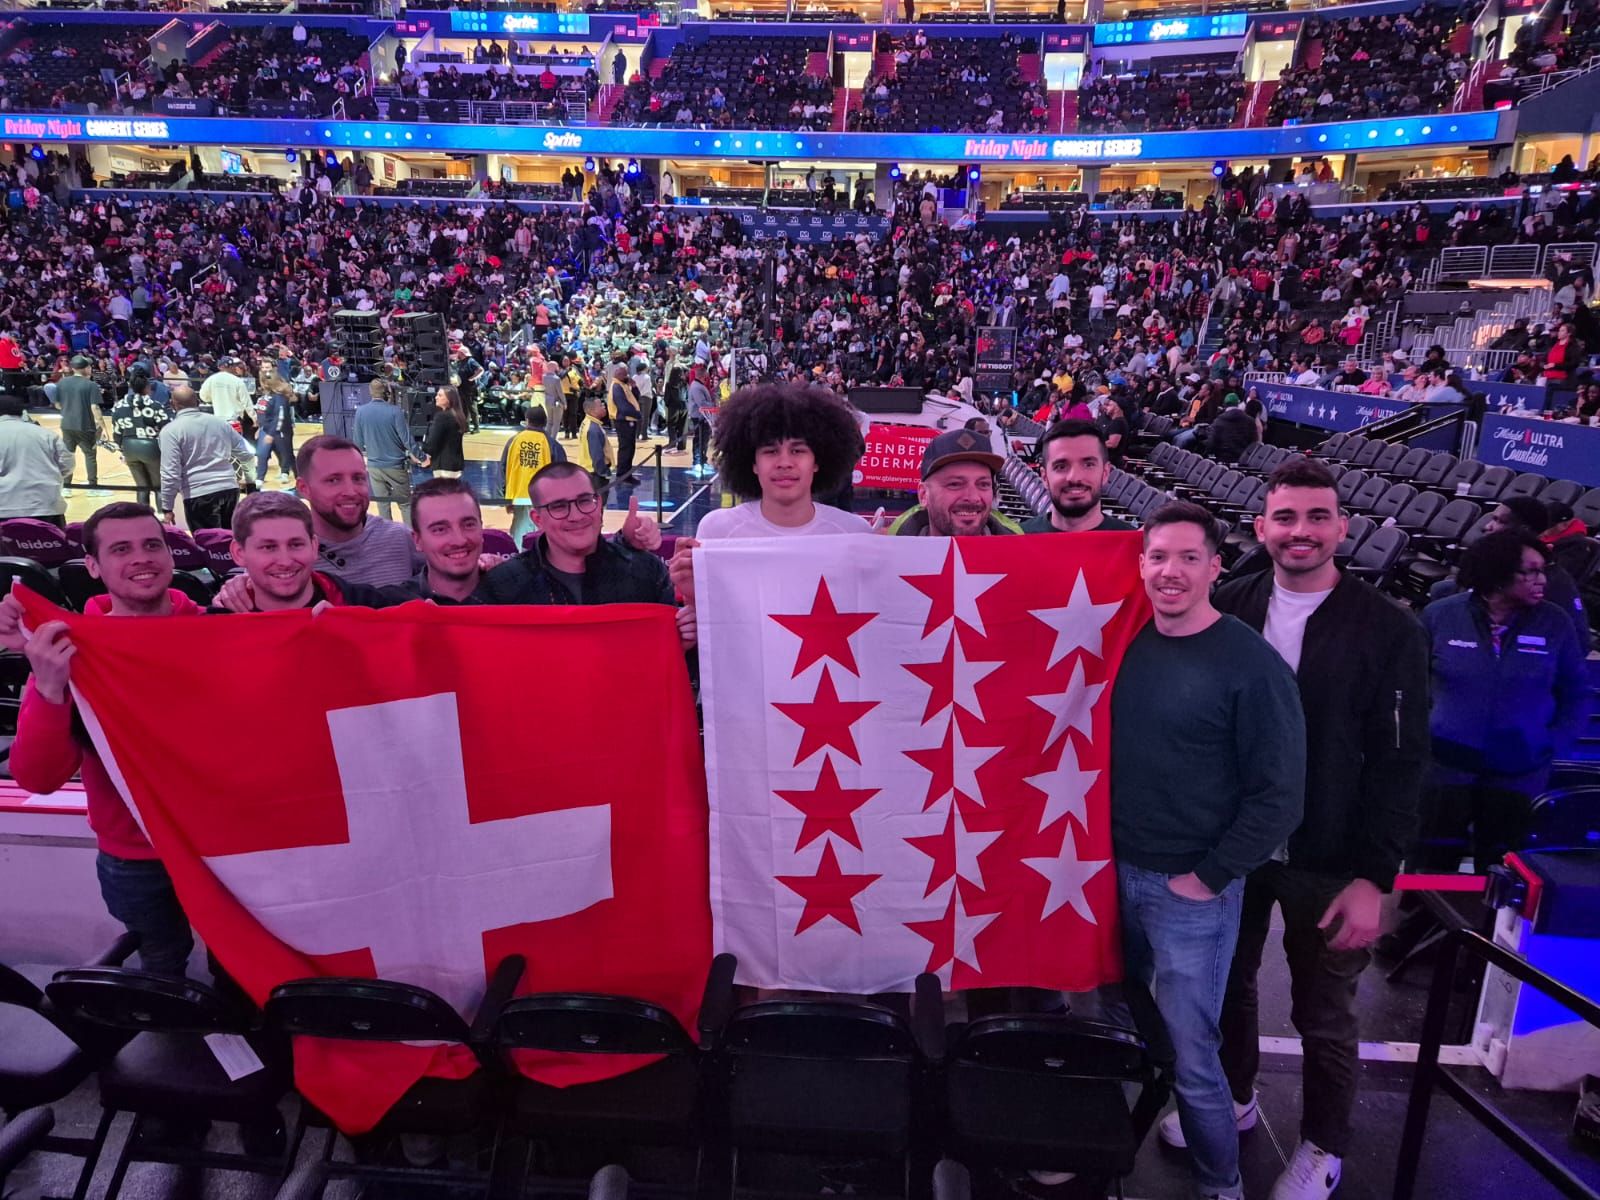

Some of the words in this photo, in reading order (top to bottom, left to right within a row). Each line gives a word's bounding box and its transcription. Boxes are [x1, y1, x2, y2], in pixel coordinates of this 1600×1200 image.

[503, 15, 539, 31] Sprite
[1149, 21, 1189, 40] Sprite
[5, 119, 45, 138] Friday
[47, 119, 81, 139] Night
[86, 119, 133, 138] CONCERT
[133, 120, 169, 138] SERIES
[543, 132, 582, 150] Sprite
[965, 139, 1009, 159] Friday
[1010, 139, 1048, 160] Night
[1053, 140, 1103, 157] CONCERT
[1104, 138, 1142, 156] SERIES
[520, 441, 541, 451] CSC
[1531, 432, 1564, 448] ULTRA
[520, 449, 540, 460] EVENT
[1502, 440, 1548, 467] Courtside
[520, 458, 539, 468] STAFF
[16, 539, 62, 550] leidos
